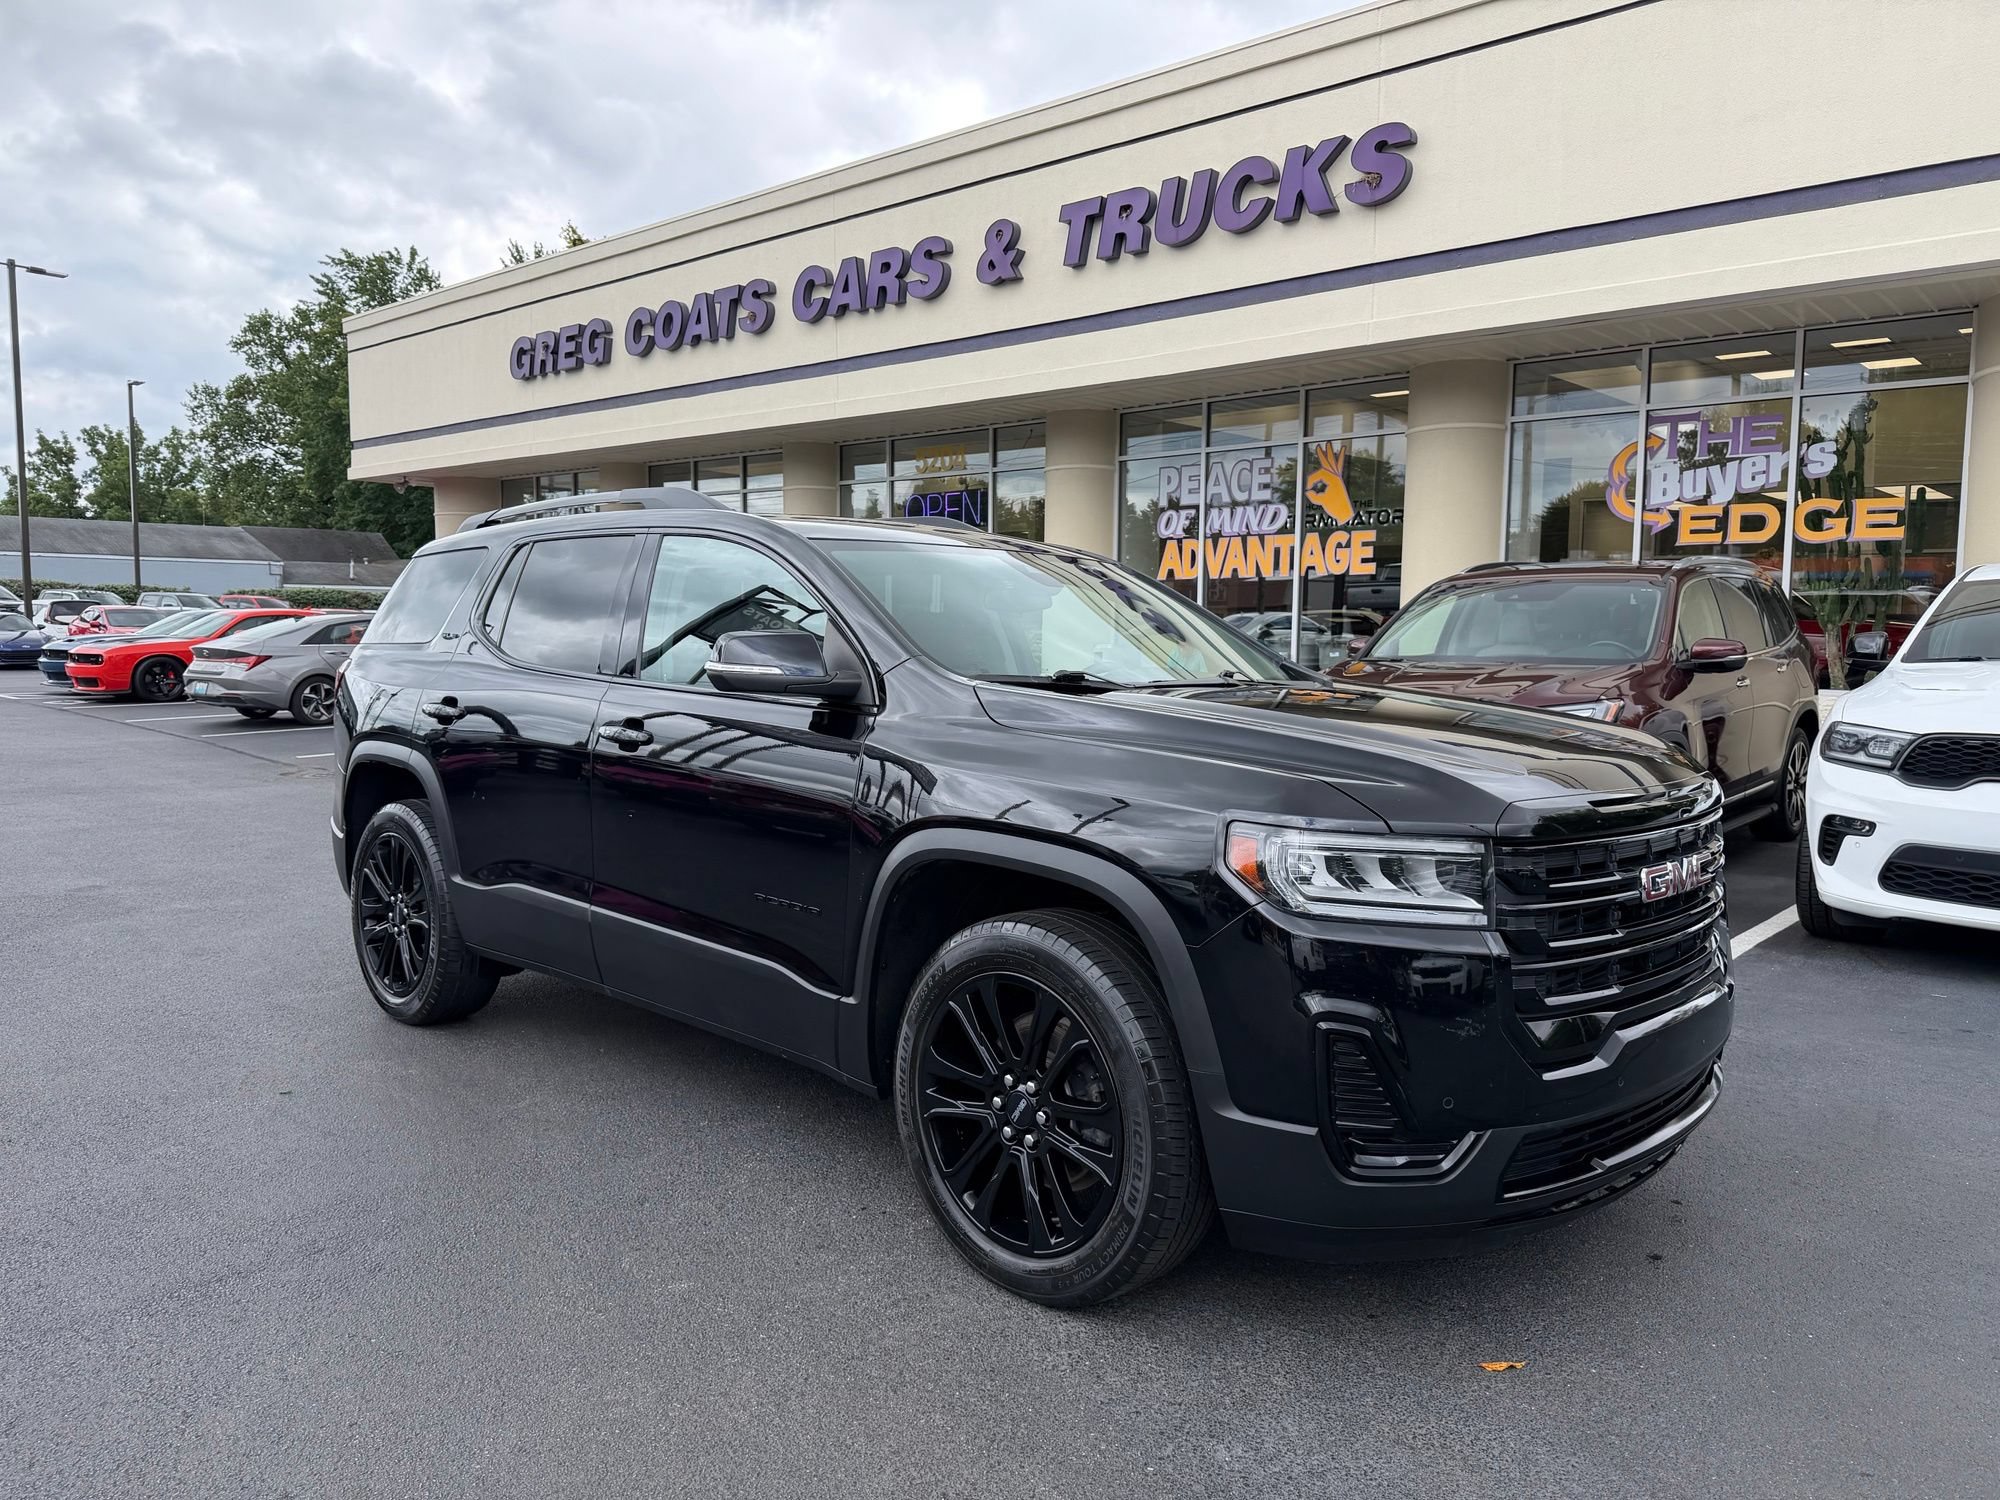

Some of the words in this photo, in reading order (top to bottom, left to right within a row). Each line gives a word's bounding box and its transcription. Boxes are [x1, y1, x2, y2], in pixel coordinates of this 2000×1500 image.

[510, 319, 613, 380] GREG
[625, 279, 776, 358] COATS
[792, 236, 953, 323] CARS
[976, 218, 1025, 286] &
[1059, 121, 1418, 269] TRUCKS
[1650, 411, 1784, 460] THE
[1158, 457, 1275, 507] PEACE
[905, 489, 981, 525] OPEN
[1157, 509, 1196, 539] OF
[1205, 503, 1289, 537] MIND
[1675, 497, 1906, 546] EDGE
[1157, 529, 1377, 580] ADVANTAGE
[1641, 853, 1715, 903] GMC
[901, 1030, 912, 1127] MICHELIN
[1099, 1221, 1129, 1267] PRIMACY
[1072, 1264, 1098, 1284] TOUR
